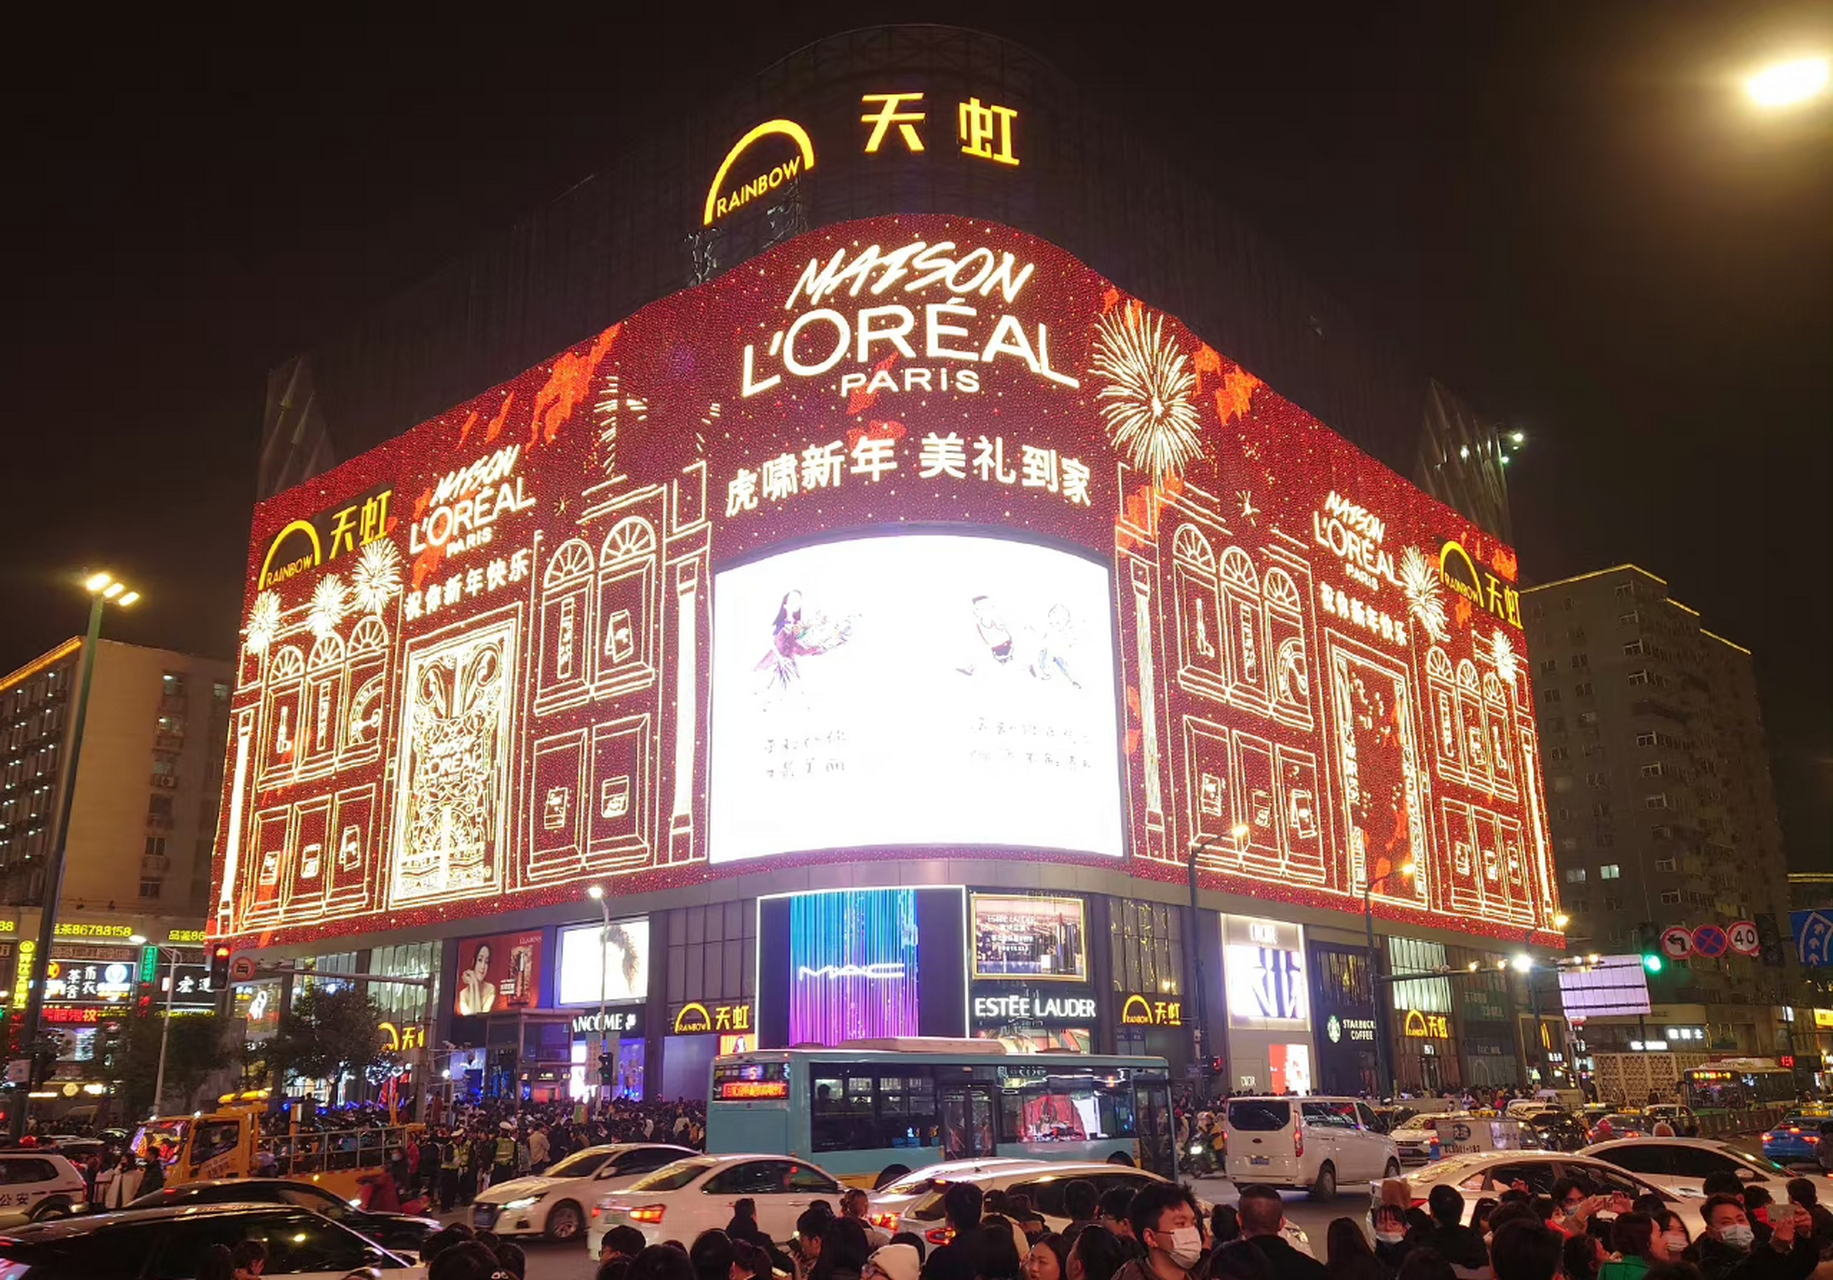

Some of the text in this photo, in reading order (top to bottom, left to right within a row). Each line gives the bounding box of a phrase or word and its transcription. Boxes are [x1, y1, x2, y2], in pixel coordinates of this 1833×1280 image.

[861, 92, 1020, 165] 天虹
[716, 156, 800, 217] RAINBOW
[785, 241, 1034, 310] MAISON
[742, 297, 1079, 397] L'ORÉAL
[840, 367, 980, 396] PARIS
[429, 444, 520, 507] MAISON
[726, 431, 1091, 517] 虎啸新年 美礼到家
[329, 490, 391, 560] 天虹
[409, 477, 536, 555] L'ORÉAL
[446, 527, 493, 558] PARIS
[1313, 511, 1405, 586] L'ORÉAL
[265, 553, 313, 588] RAINBOW
[1345, 563, 1378, 591] PARIS
[1444, 572, 1479, 603] RAINBOW
[1484, 572, 1524, 630] 天虹
[1734, 928, 1756, 945] 40
[716, 1005, 750, 1030] 天虹
[1035, 998, 1096, 1017] LAUDER
[1154, 1001, 1181, 1025] 天虹
[679, 1022, 707, 1032] RAINBOW
[1342, 1019, 1376, 1029] STARBUCK
[1350, 1030, 1373, 1040] COFFEE
[1427, 1015, 1448, 1038] 天虹
[0, 1192, 29, 1206] 公安
